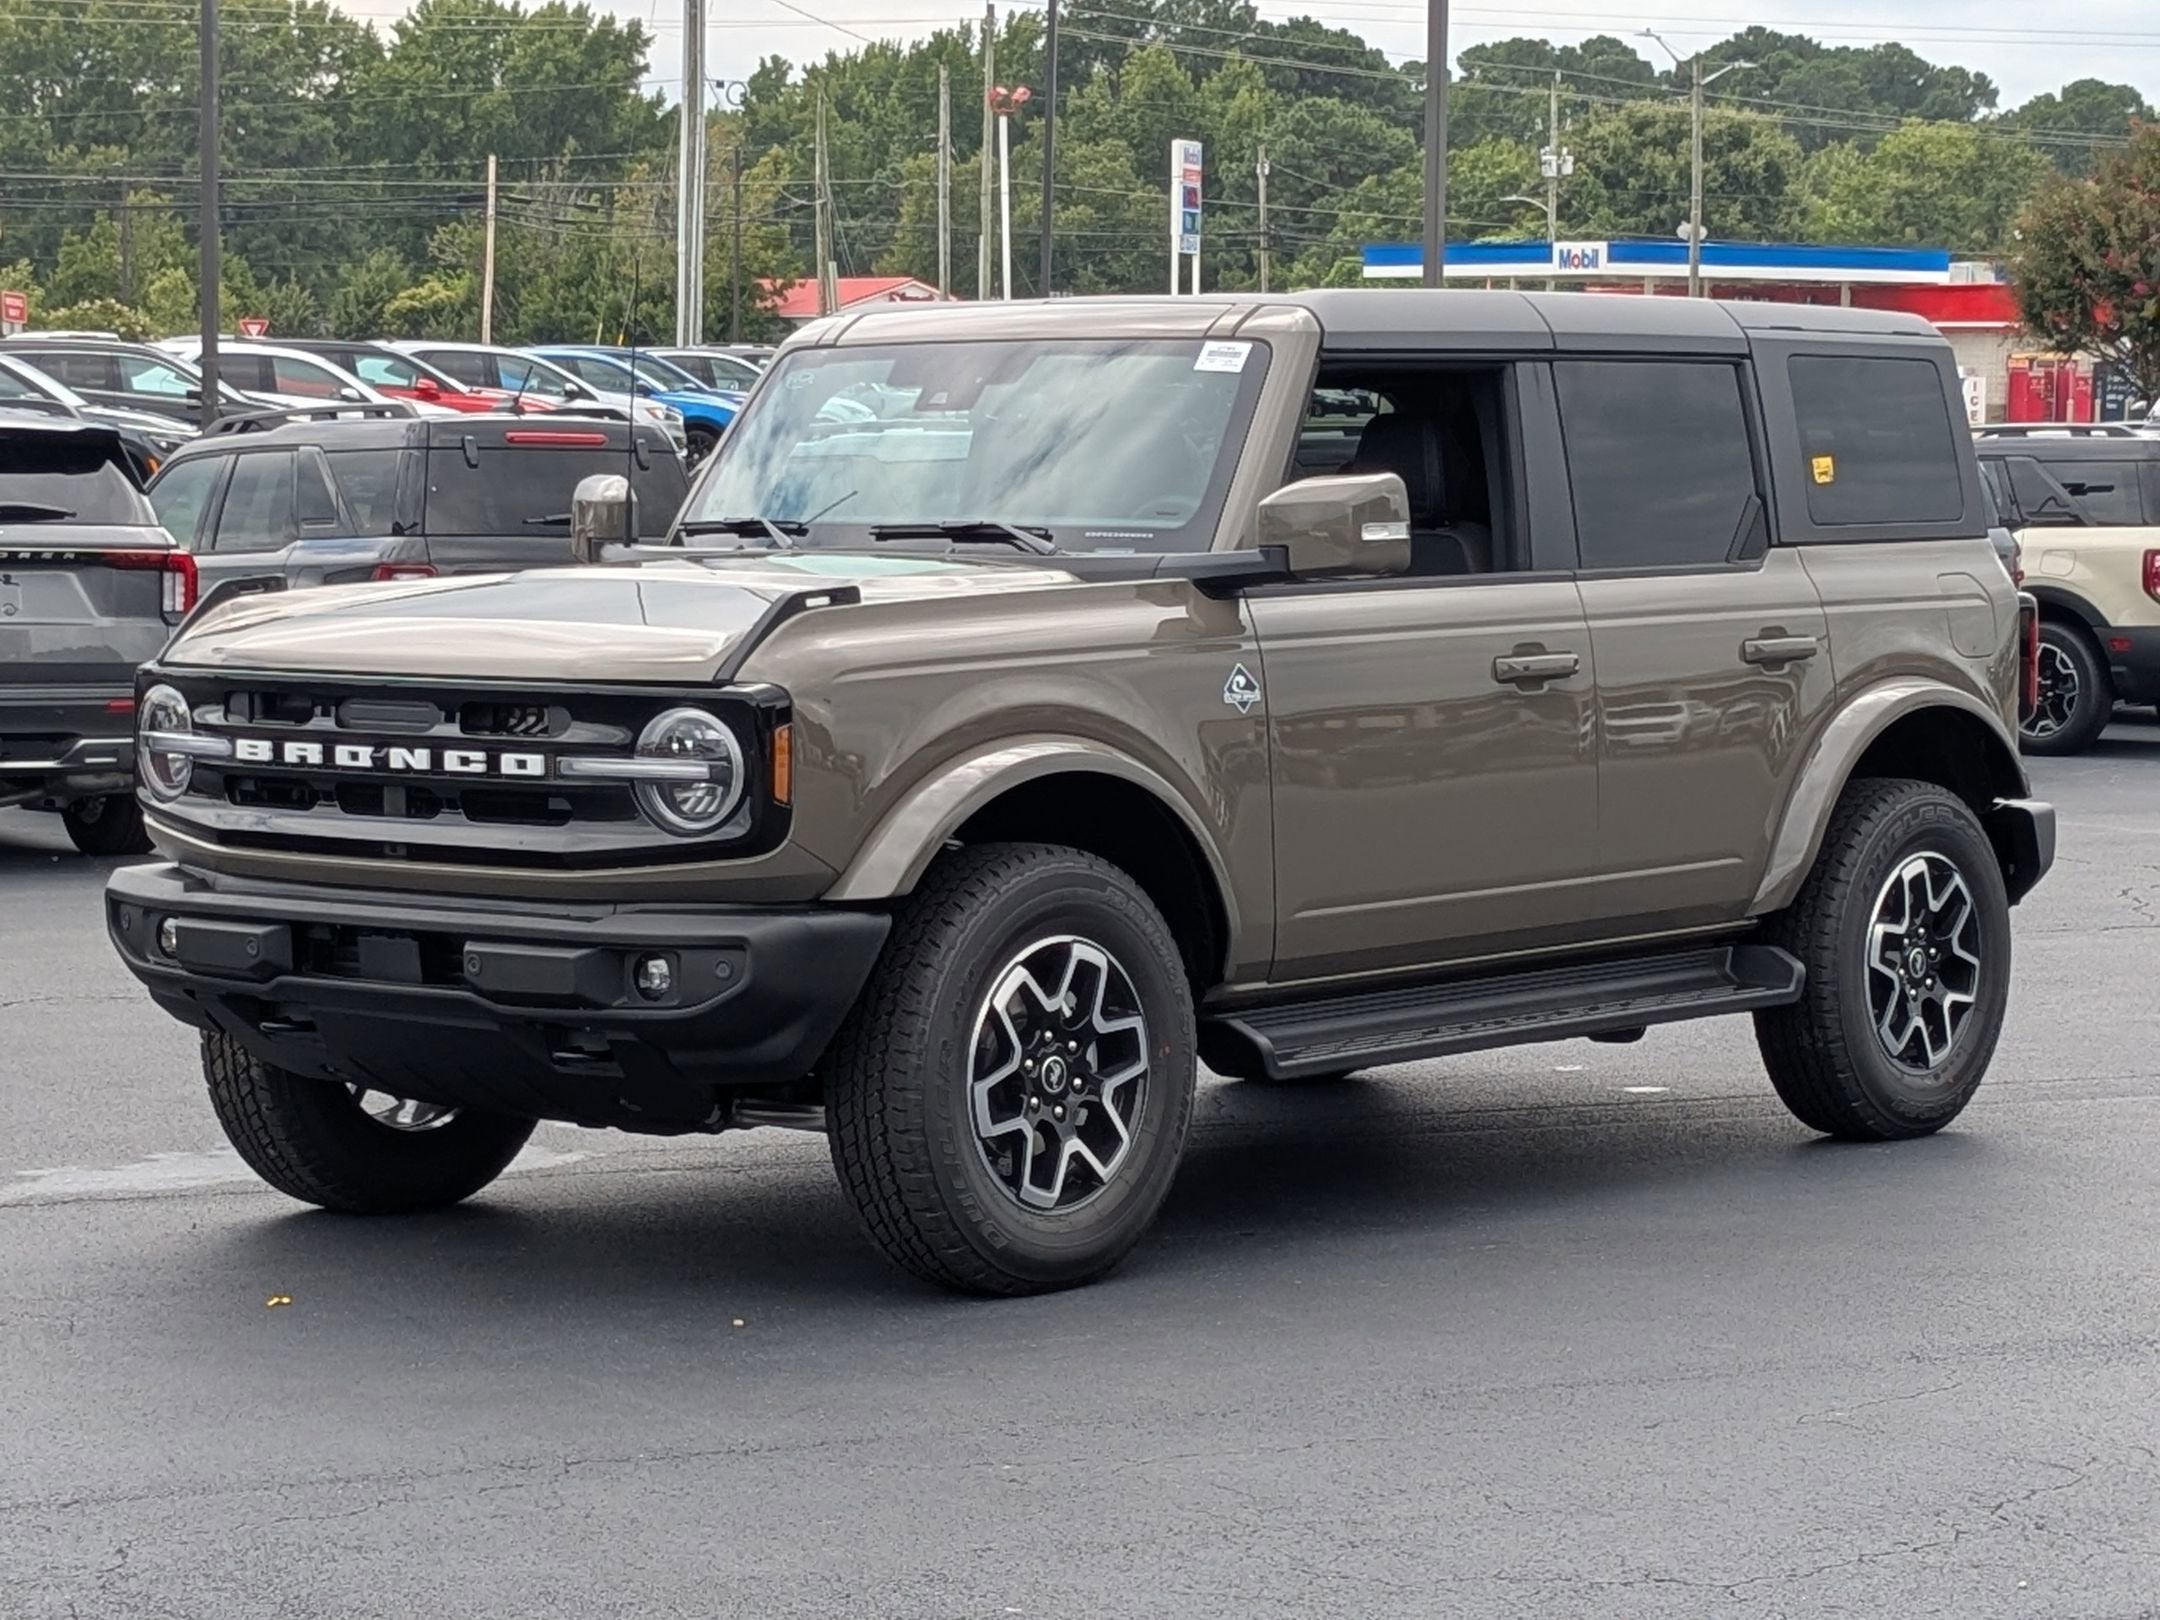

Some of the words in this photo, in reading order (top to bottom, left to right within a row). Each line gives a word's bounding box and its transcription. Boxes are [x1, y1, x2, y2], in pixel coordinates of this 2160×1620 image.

[1559, 248, 1599, 269] Mobil
[1969, 381, 1979, 422] ICE
[235, 739, 545, 776] BRONCO
